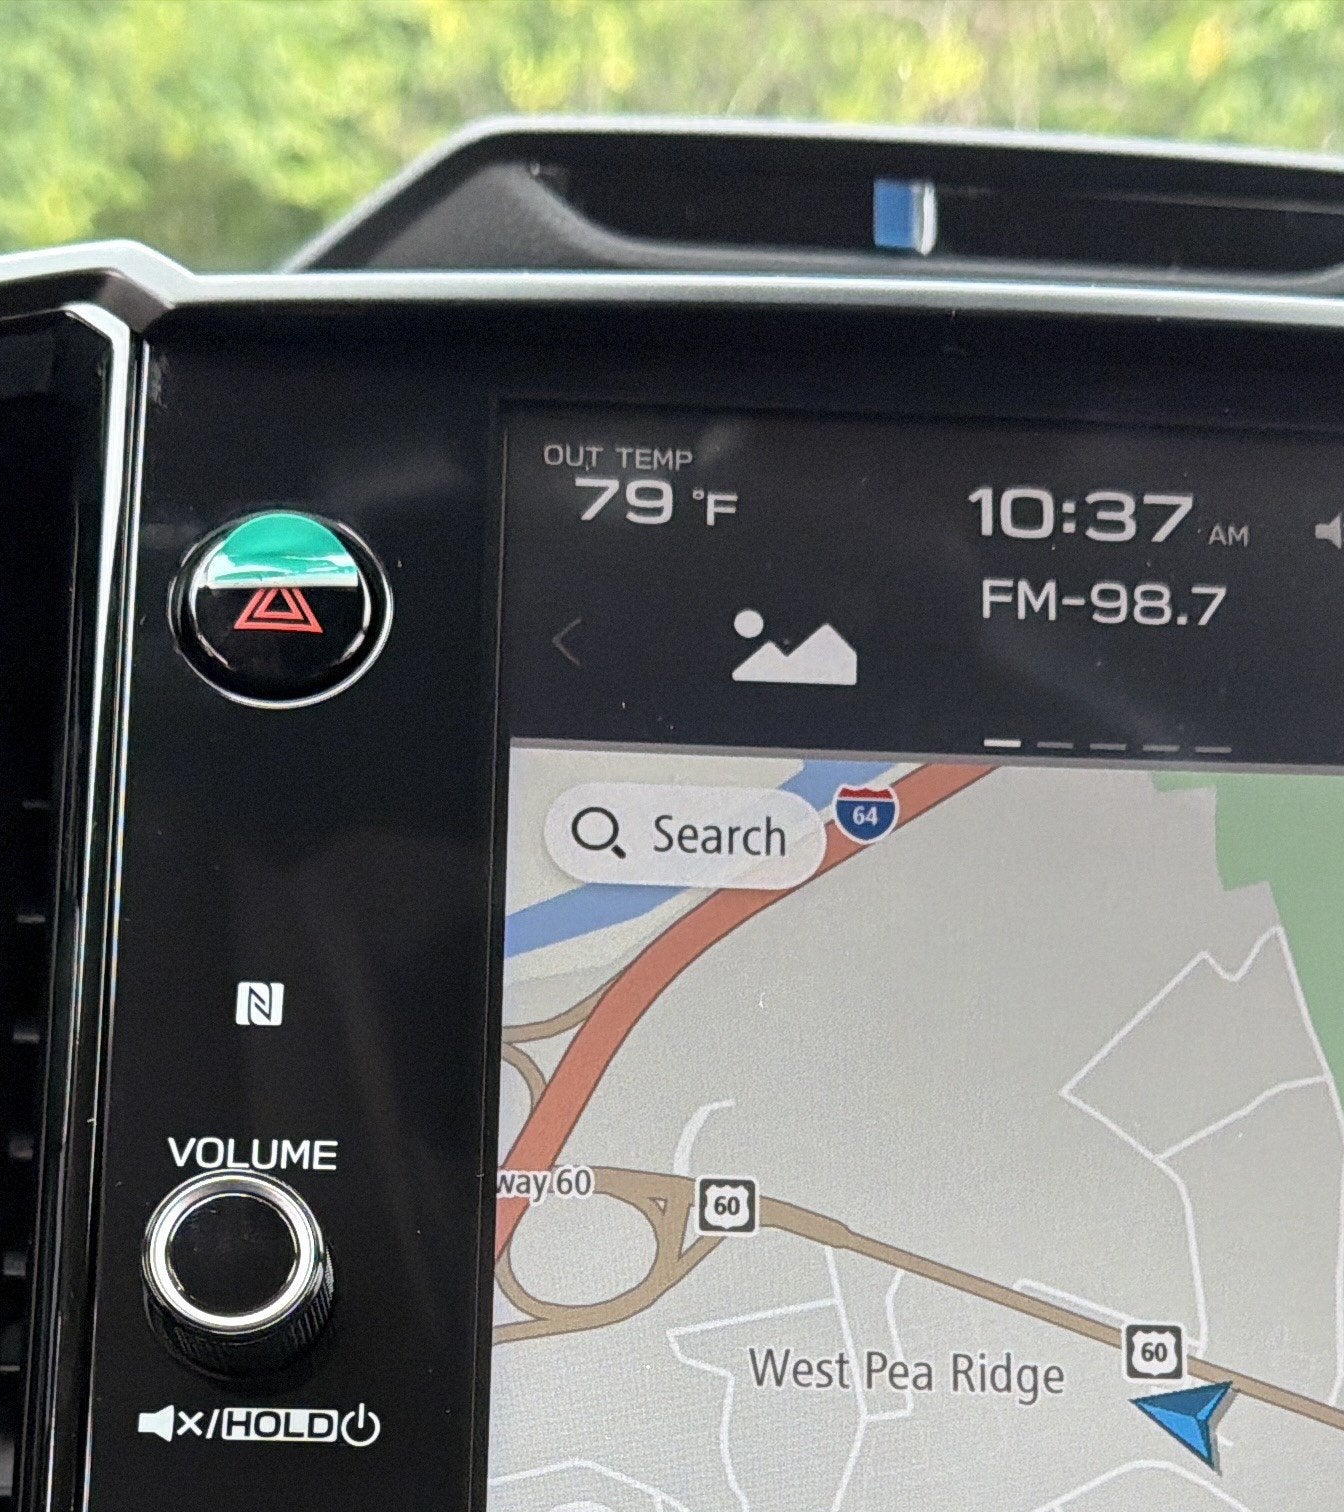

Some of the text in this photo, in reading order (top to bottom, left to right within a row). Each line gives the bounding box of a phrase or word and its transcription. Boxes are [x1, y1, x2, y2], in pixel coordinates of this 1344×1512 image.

[543, 444, 694, 472] OUT TEMP
[574, 477, 674, 525] 79
[968, 487, 1251, 548] 10:37 AM
[981, 578, 1228, 627] FM-98.7
[852, 806, 878, 827] 64
[653, 814, 788, 858] Search
[167, 1136, 339, 1171] VOLUME
[556, 1168, 592, 1197] 60
[712, 1195, 741, 1218] 60
[1140, 1342, 1168, 1364] 60
[748, 1347, 1065, 1405] West Pea Ridge
